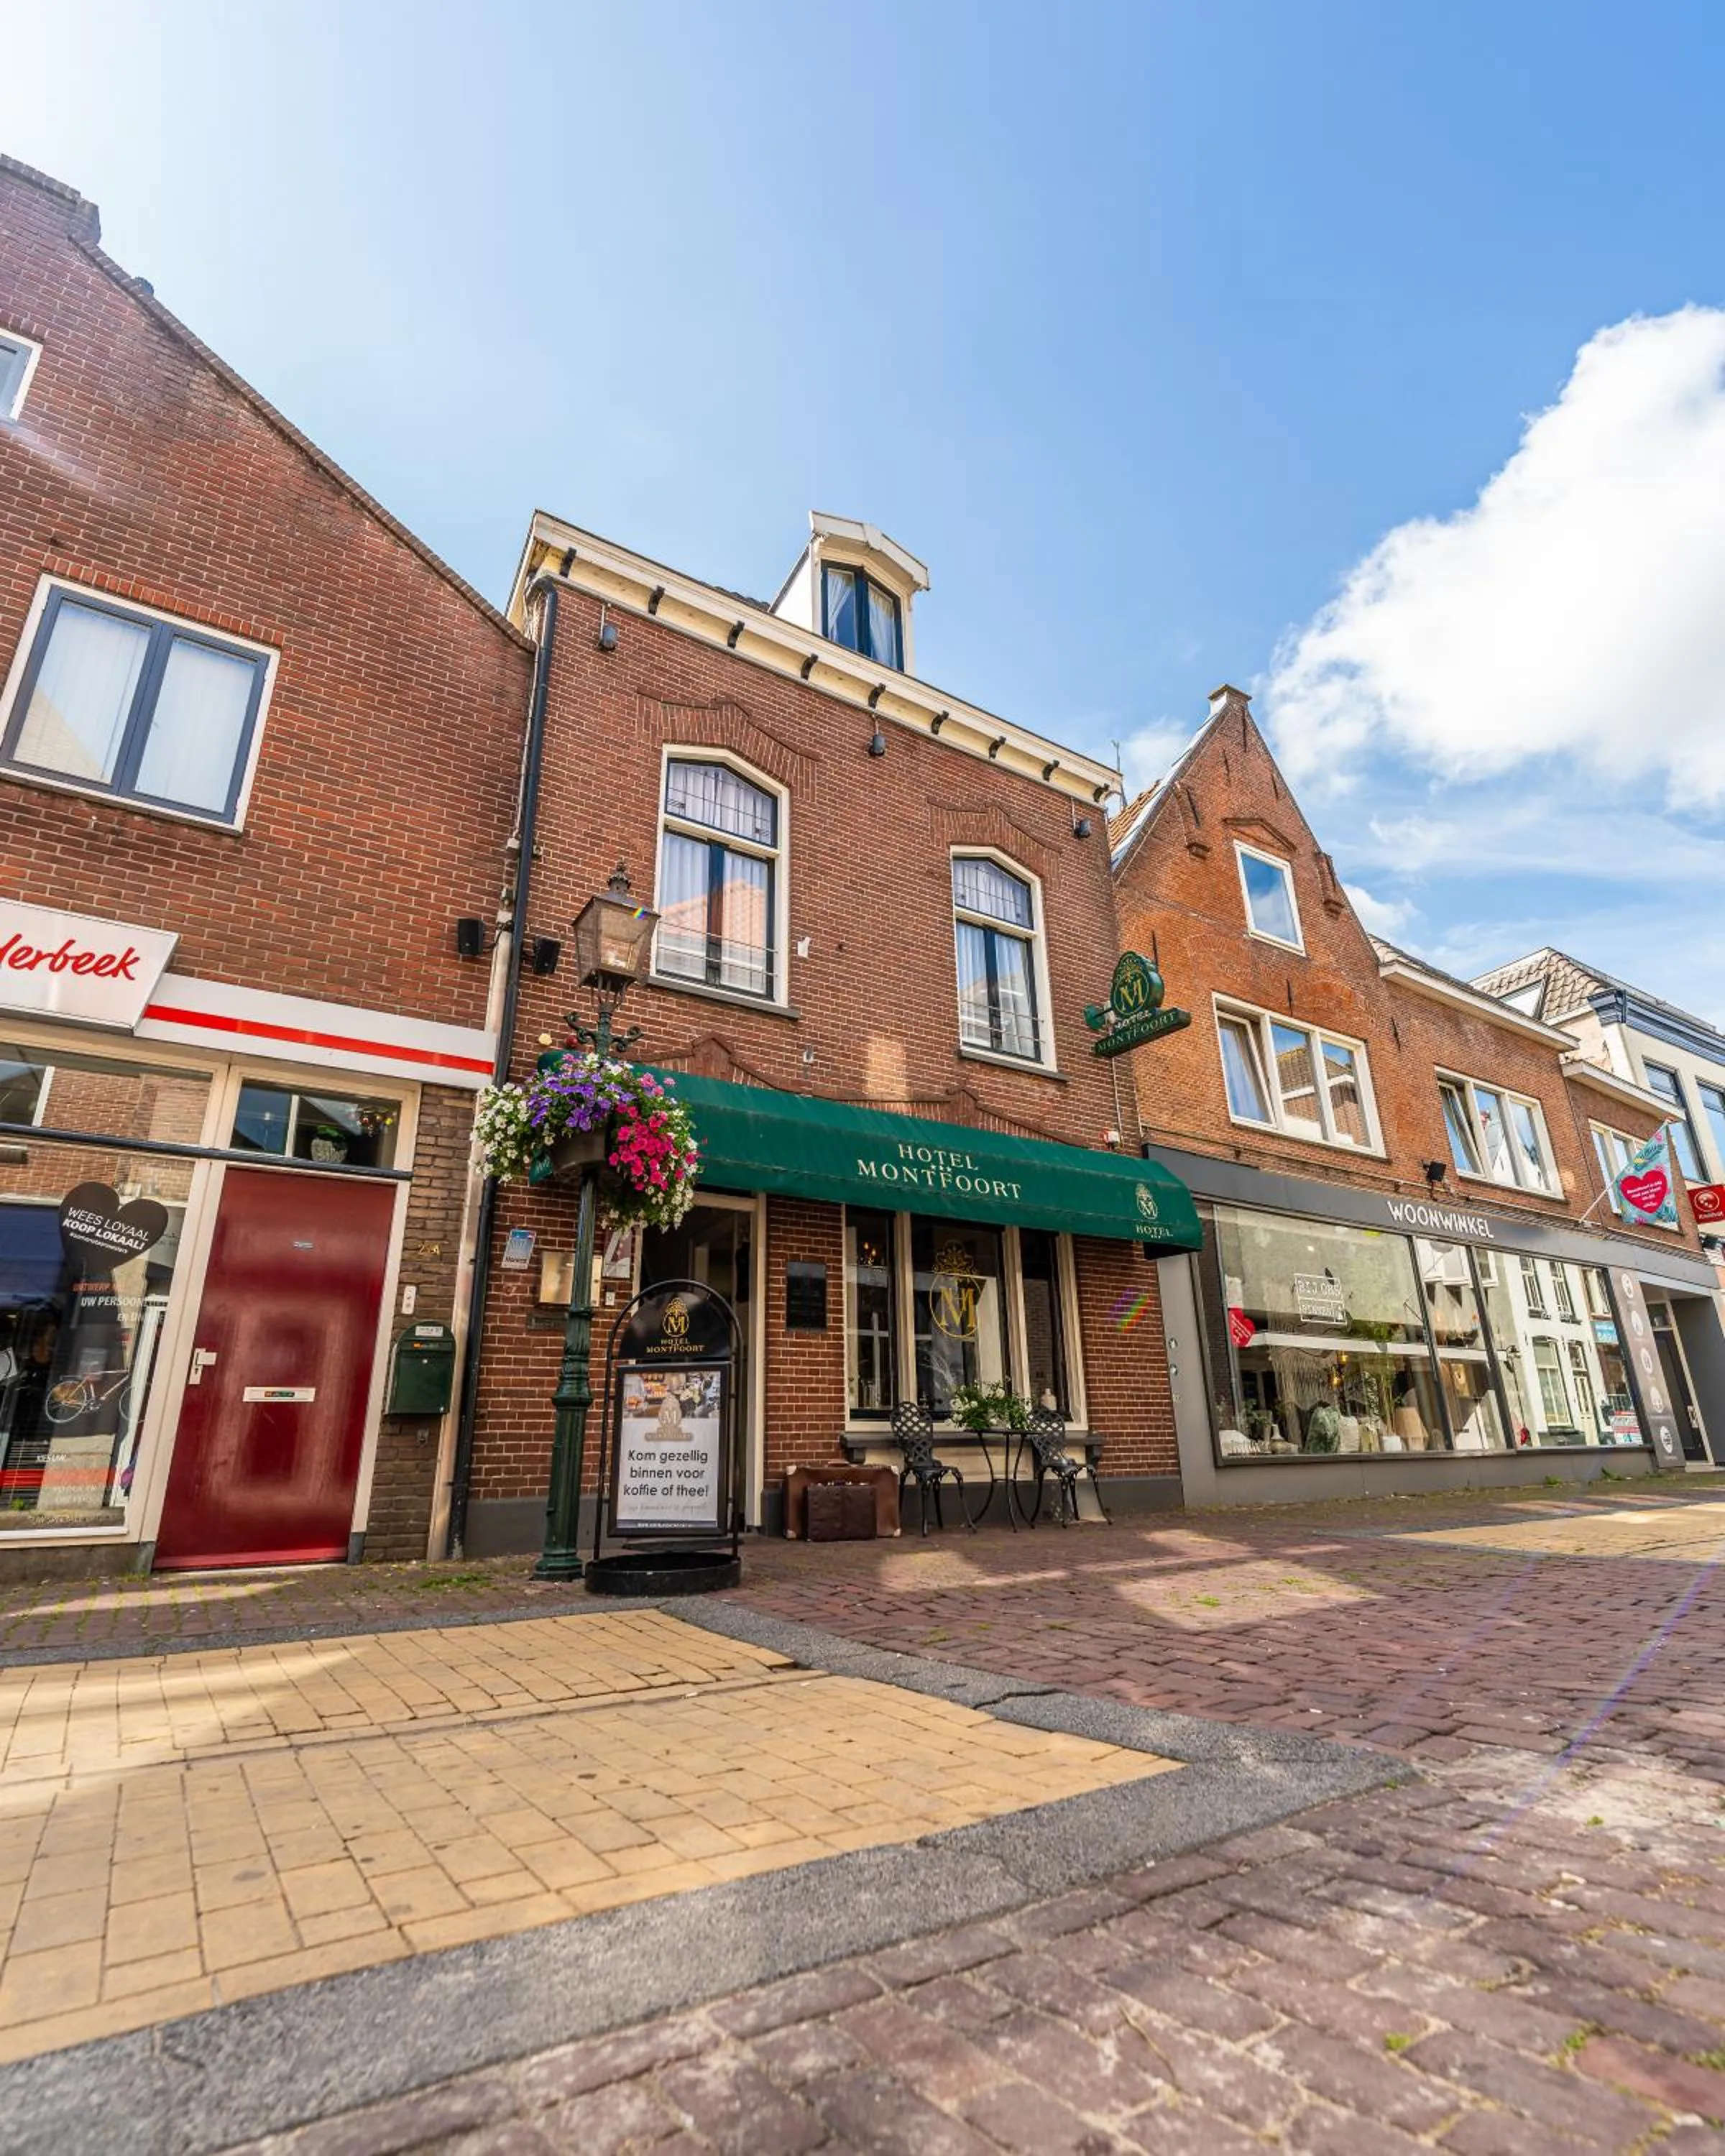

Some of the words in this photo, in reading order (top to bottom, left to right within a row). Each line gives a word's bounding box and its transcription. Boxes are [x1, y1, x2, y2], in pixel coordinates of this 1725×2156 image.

[1098, 1011, 1177, 1053] MONTFOORT
[898, 1143, 978, 1171] HOTEL
[857, 1159, 1021, 1199] MONTFOORT
[62, 1218, 96, 1234] KOOP
[68, 1207, 104, 1225] WEES
[104, 1219, 149, 1241] LOYAAL
[1386, 1200, 1494, 1238] WOONWINKEL
[1136, 1224, 1174, 1237] HOTEL
[647, 1345, 704, 1353] MONTFOORT
[628, 1449, 656, 1461] Kom
[659, 1450, 708, 1464] gezellig
[630, 1467, 672, 1478] binnen
[676, 1469, 704, 1478] voor
[623, 1484, 658, 1496] koffie
[661, 1485, 674, 1496] of
[676, 1485, 709, 1497] thee!
